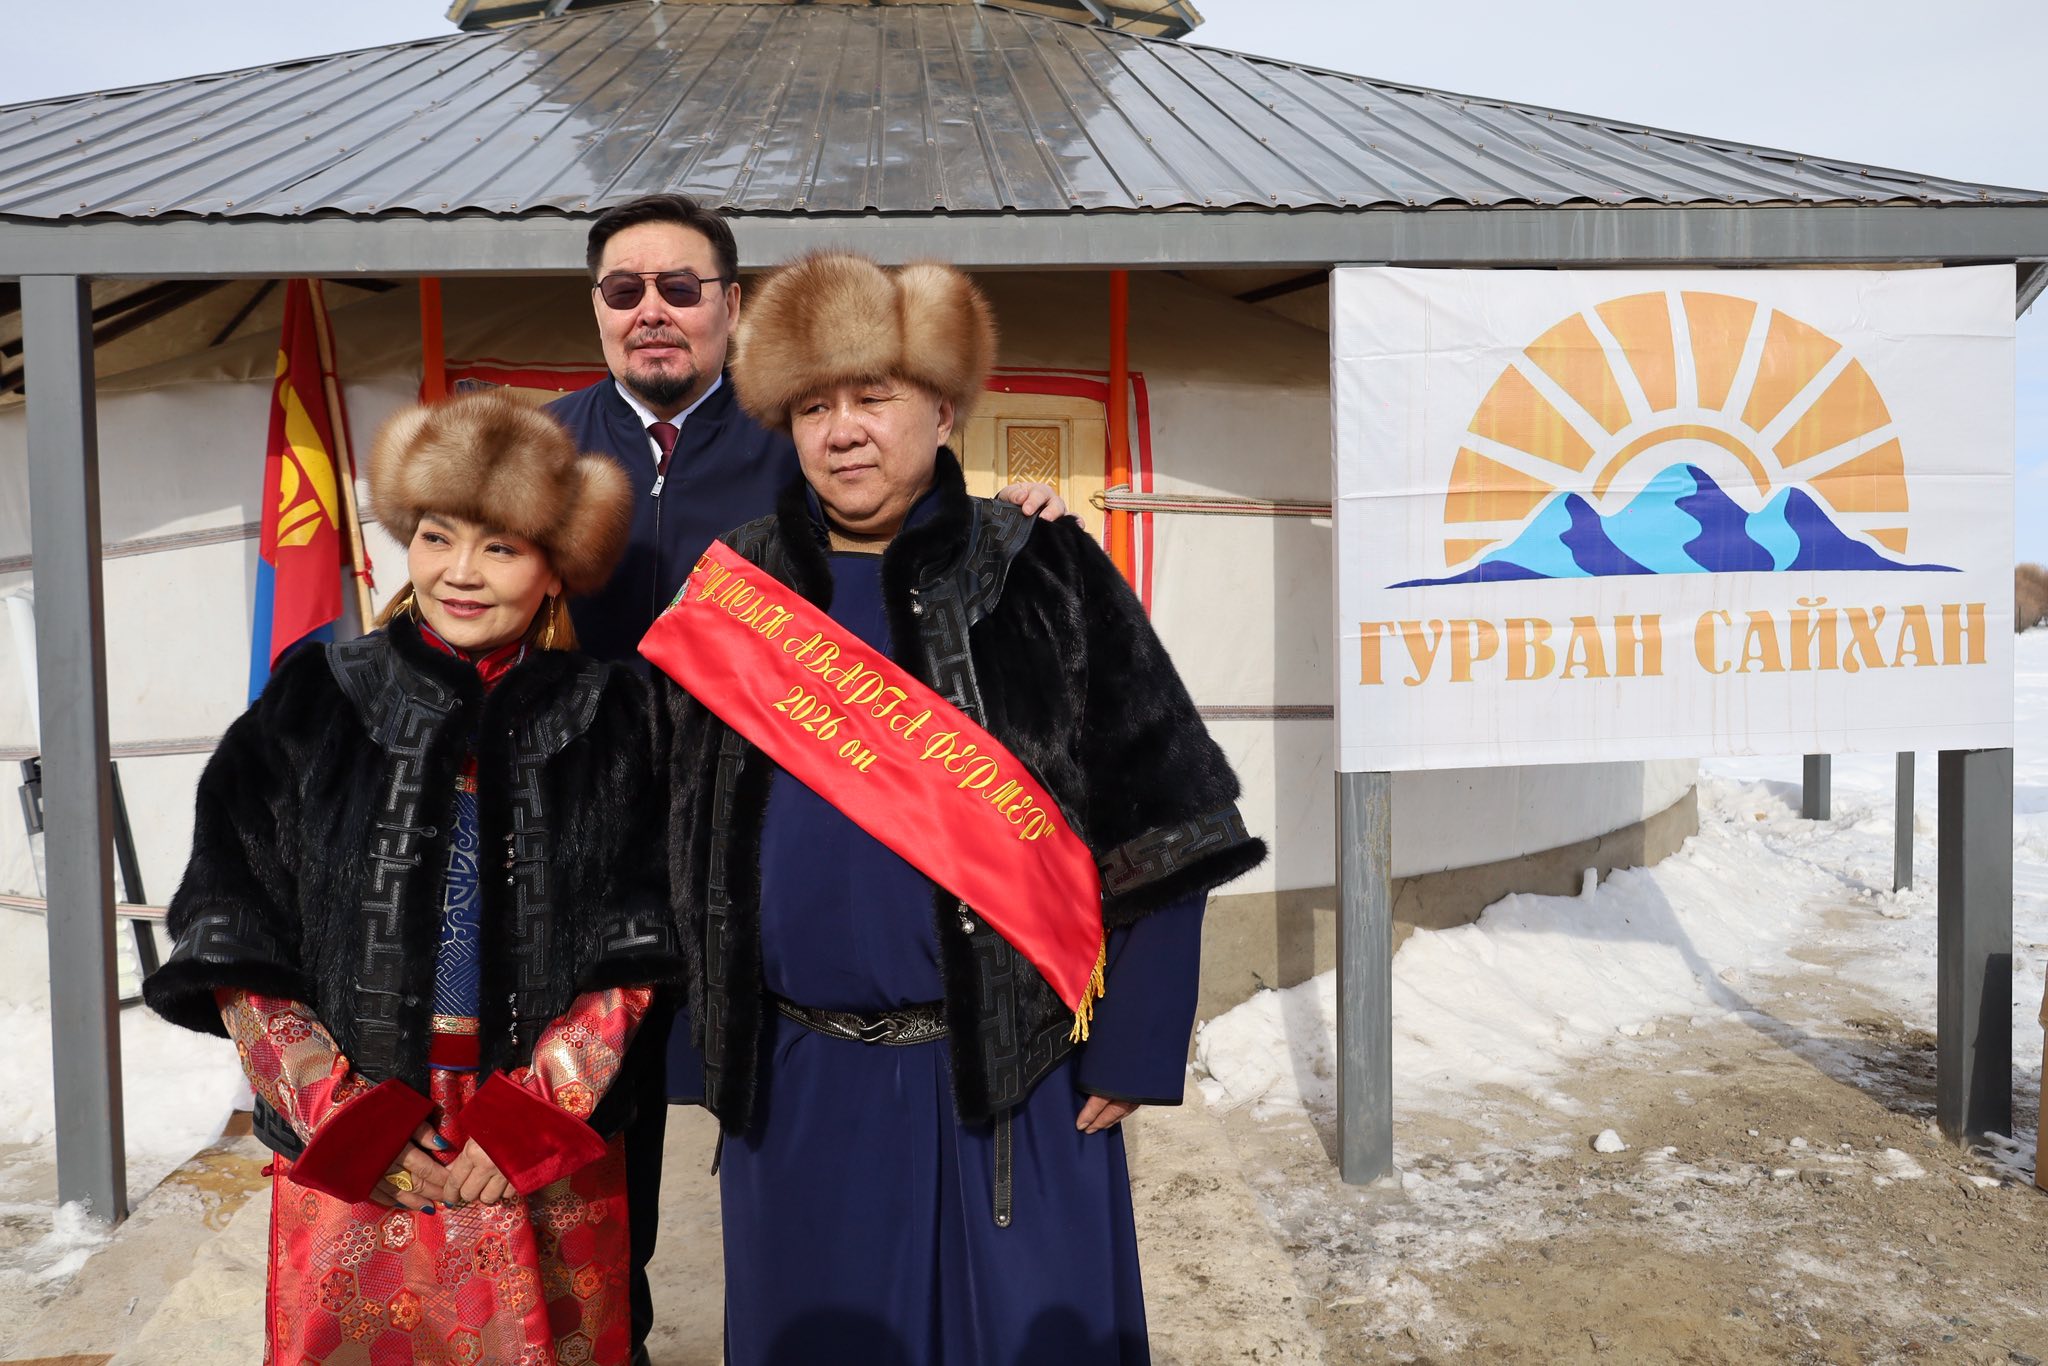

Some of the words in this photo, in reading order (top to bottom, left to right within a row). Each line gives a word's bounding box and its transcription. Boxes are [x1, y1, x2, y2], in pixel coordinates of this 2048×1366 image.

[782, 632, 932, 740] АВАРГА
[1359, 614, 1664, 687] ГУРВАН
[1694, 597, 1987, 674] САЙХАН
[772, 686, 845, 740] 2026
[838, 739, 877, 772] он
